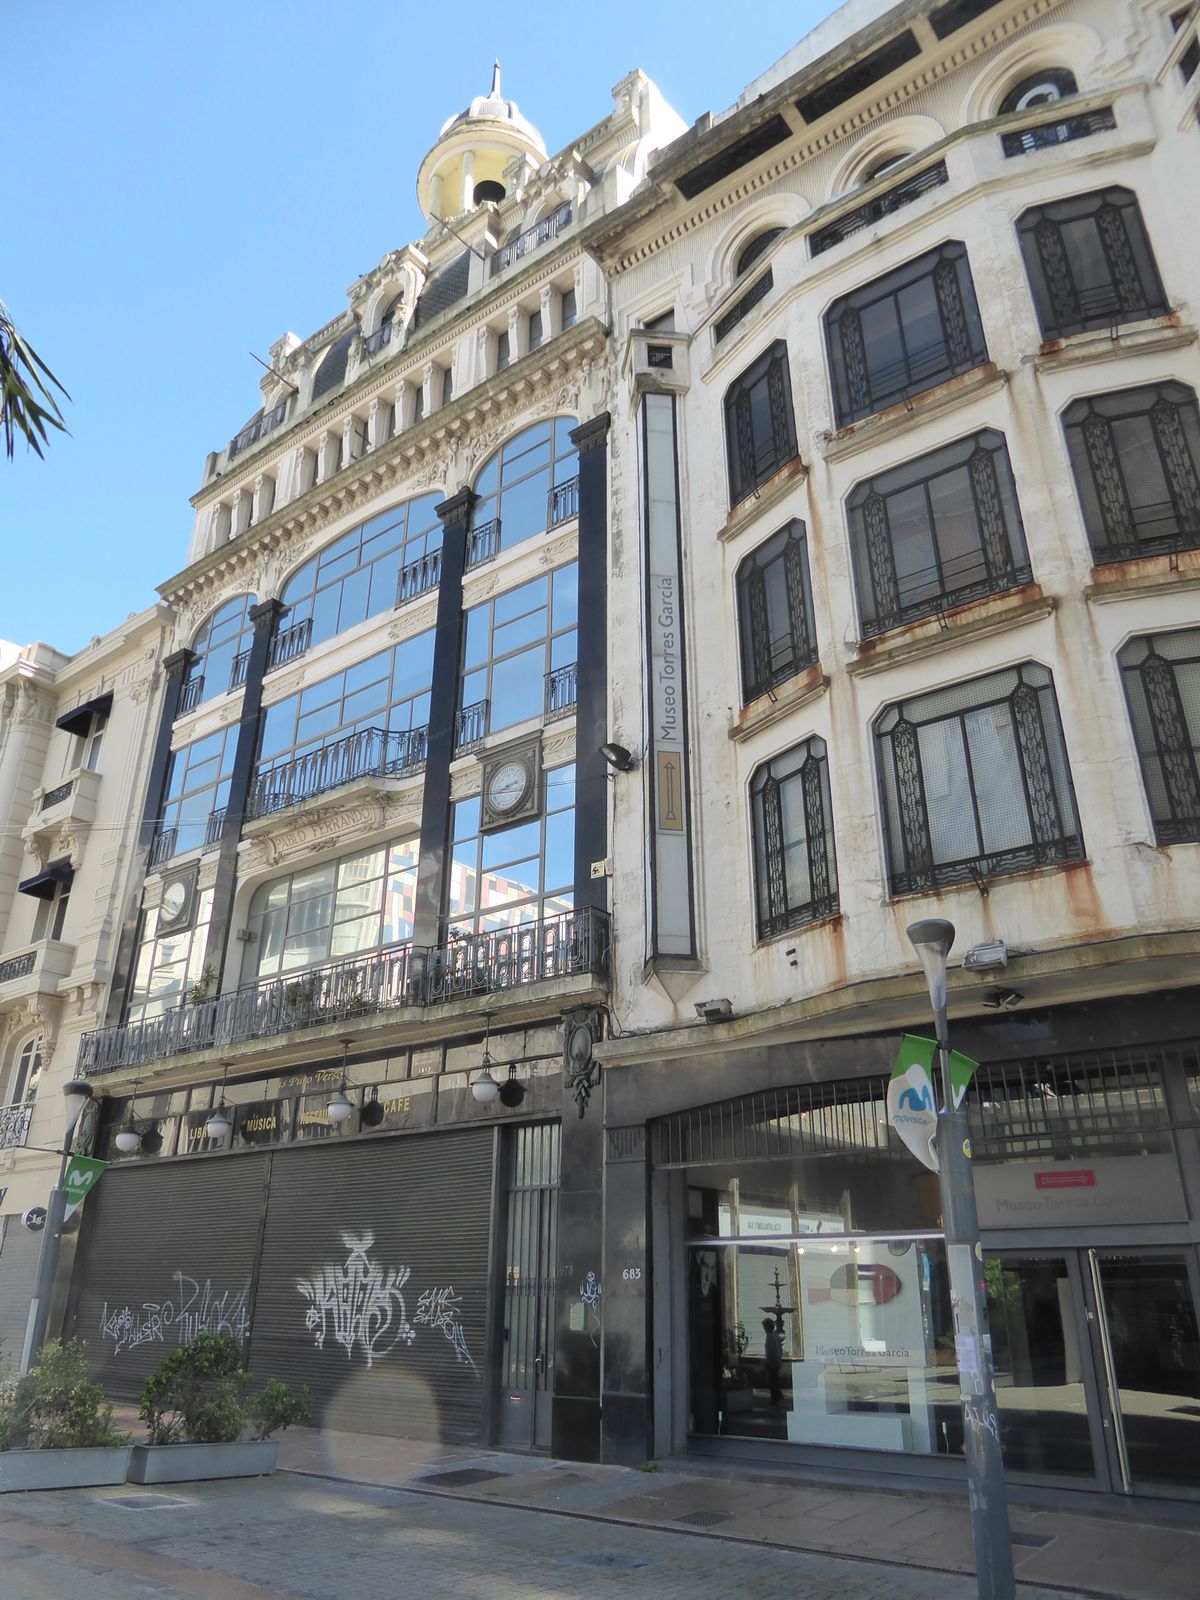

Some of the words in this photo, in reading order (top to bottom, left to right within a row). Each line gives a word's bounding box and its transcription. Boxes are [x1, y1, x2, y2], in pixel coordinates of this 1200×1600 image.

[657, 577, 674, 628] García
[659, 632, 675, 684] Torres
[660, 685, 677, 741] Museo
[276, 829, 307, 850] PABLO
[312, 806, 370, 838] FERRANDO
[246, 1114, 277, 1132] MÚSICA
[893, 1113, 931, 1126] movistar
[995, 1198, 1042, 1213] Museo
[1044, 1195, 1091, 1210] Torres
[622, 1268, 641, 1280] 683
[815, 1345, 846, 1356] Museo
